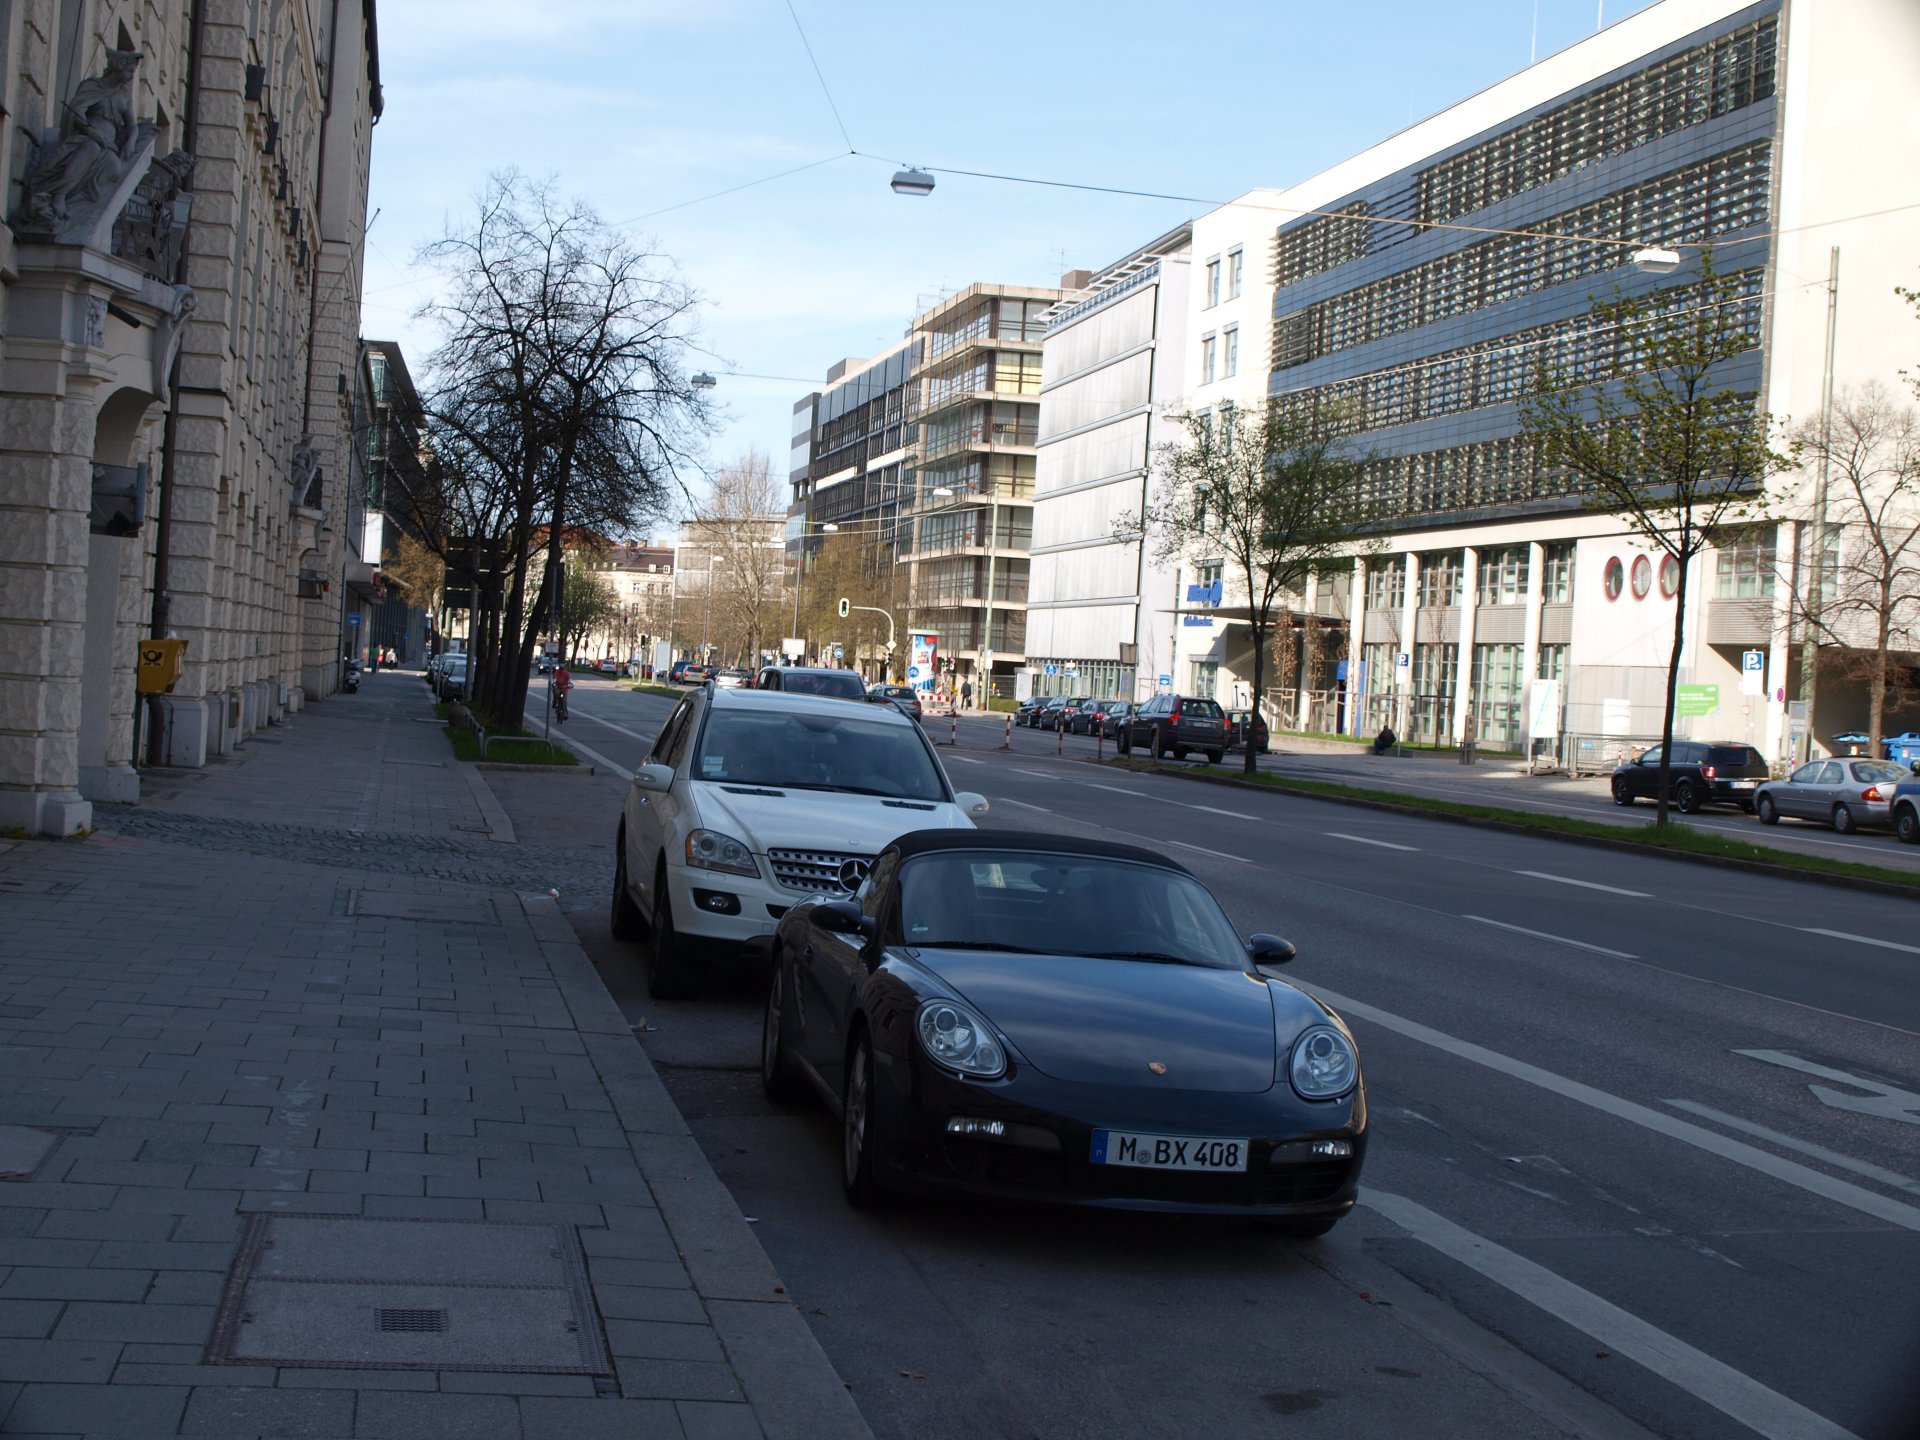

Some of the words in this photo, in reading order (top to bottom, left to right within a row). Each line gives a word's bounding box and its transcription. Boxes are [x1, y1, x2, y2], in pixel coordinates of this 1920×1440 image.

[1747, 654, 1759, 669] P
[1118, 1136, 1137, 1162] M
[1154, 1139, 1189, 1166] BX
[1193, 1141, 1239, 1168] 408
